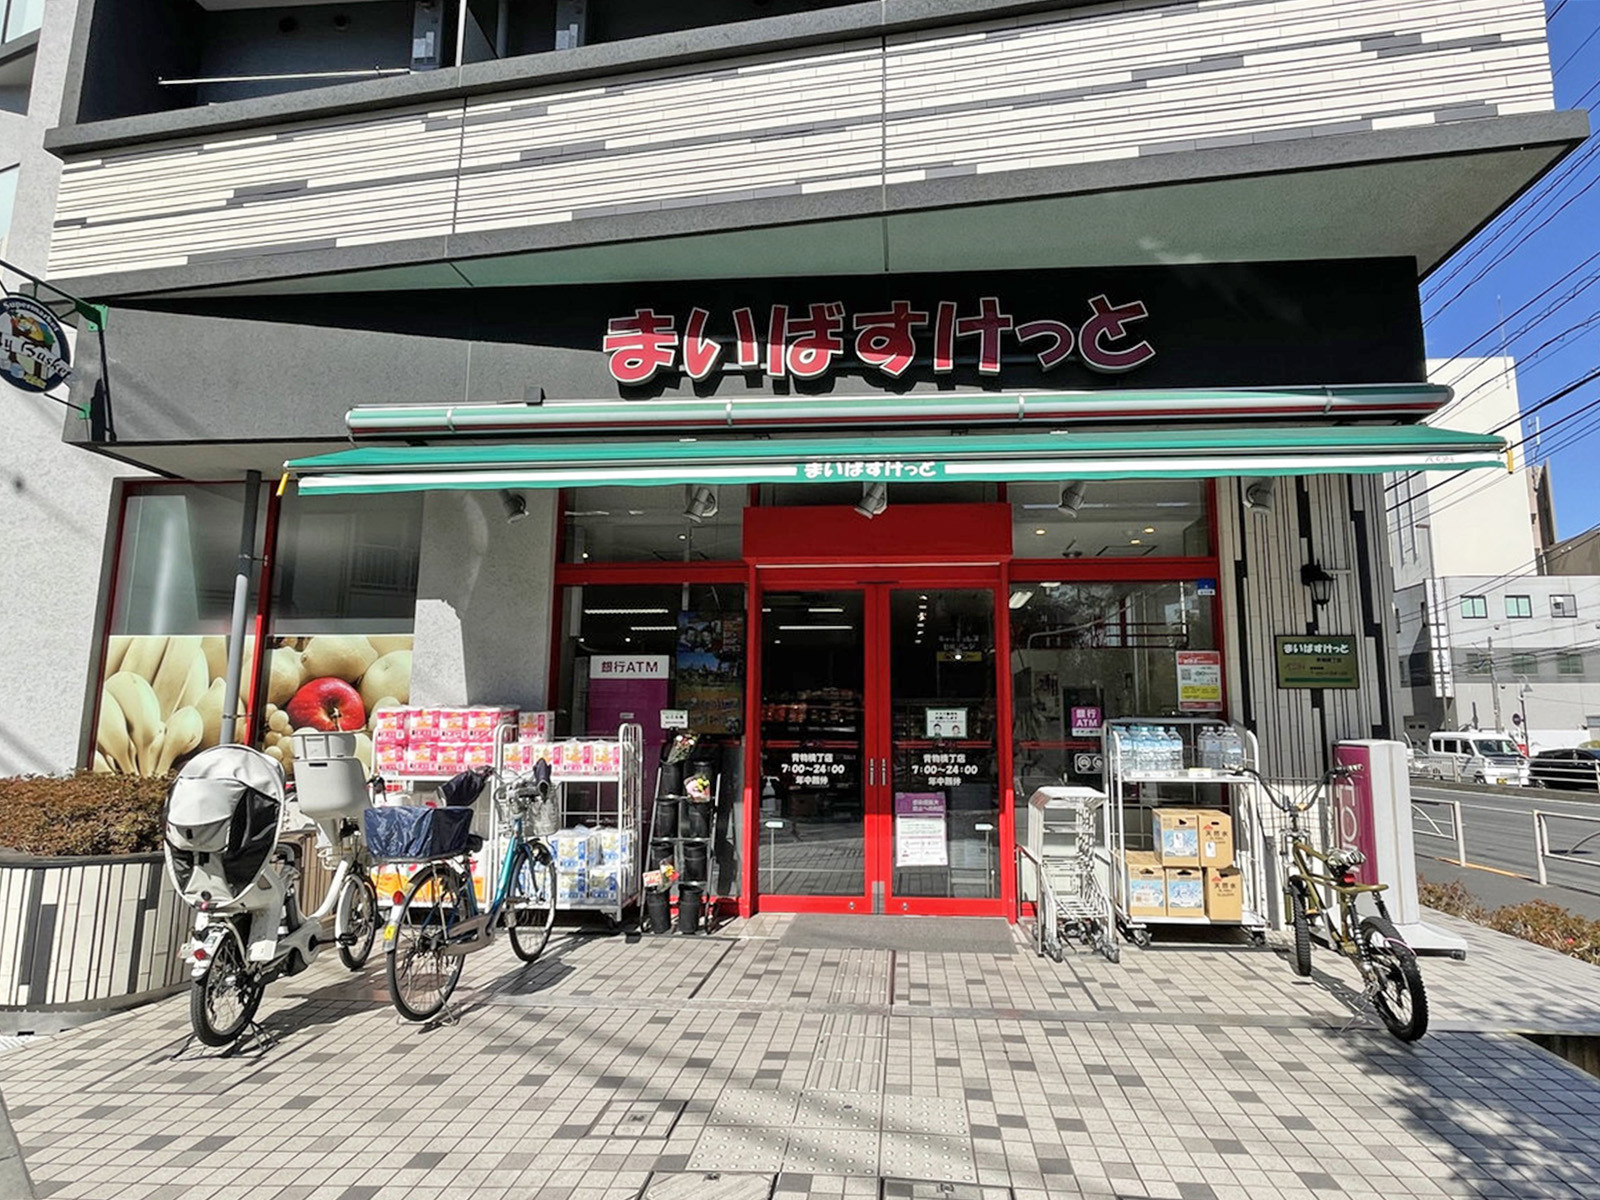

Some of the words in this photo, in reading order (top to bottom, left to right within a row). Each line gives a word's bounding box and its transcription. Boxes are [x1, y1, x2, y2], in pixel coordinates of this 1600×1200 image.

[0, 333, 13, 352] y
[603, 294, 1155, 385] まいばすけっと
[804, 461, 937, 479] まいばすけっと
[1283, 643, 1350, 654] まいばすけっと
[601, 660, 659, 673] 銀行ATM
[1076, 718, 1098, 727] ATM
